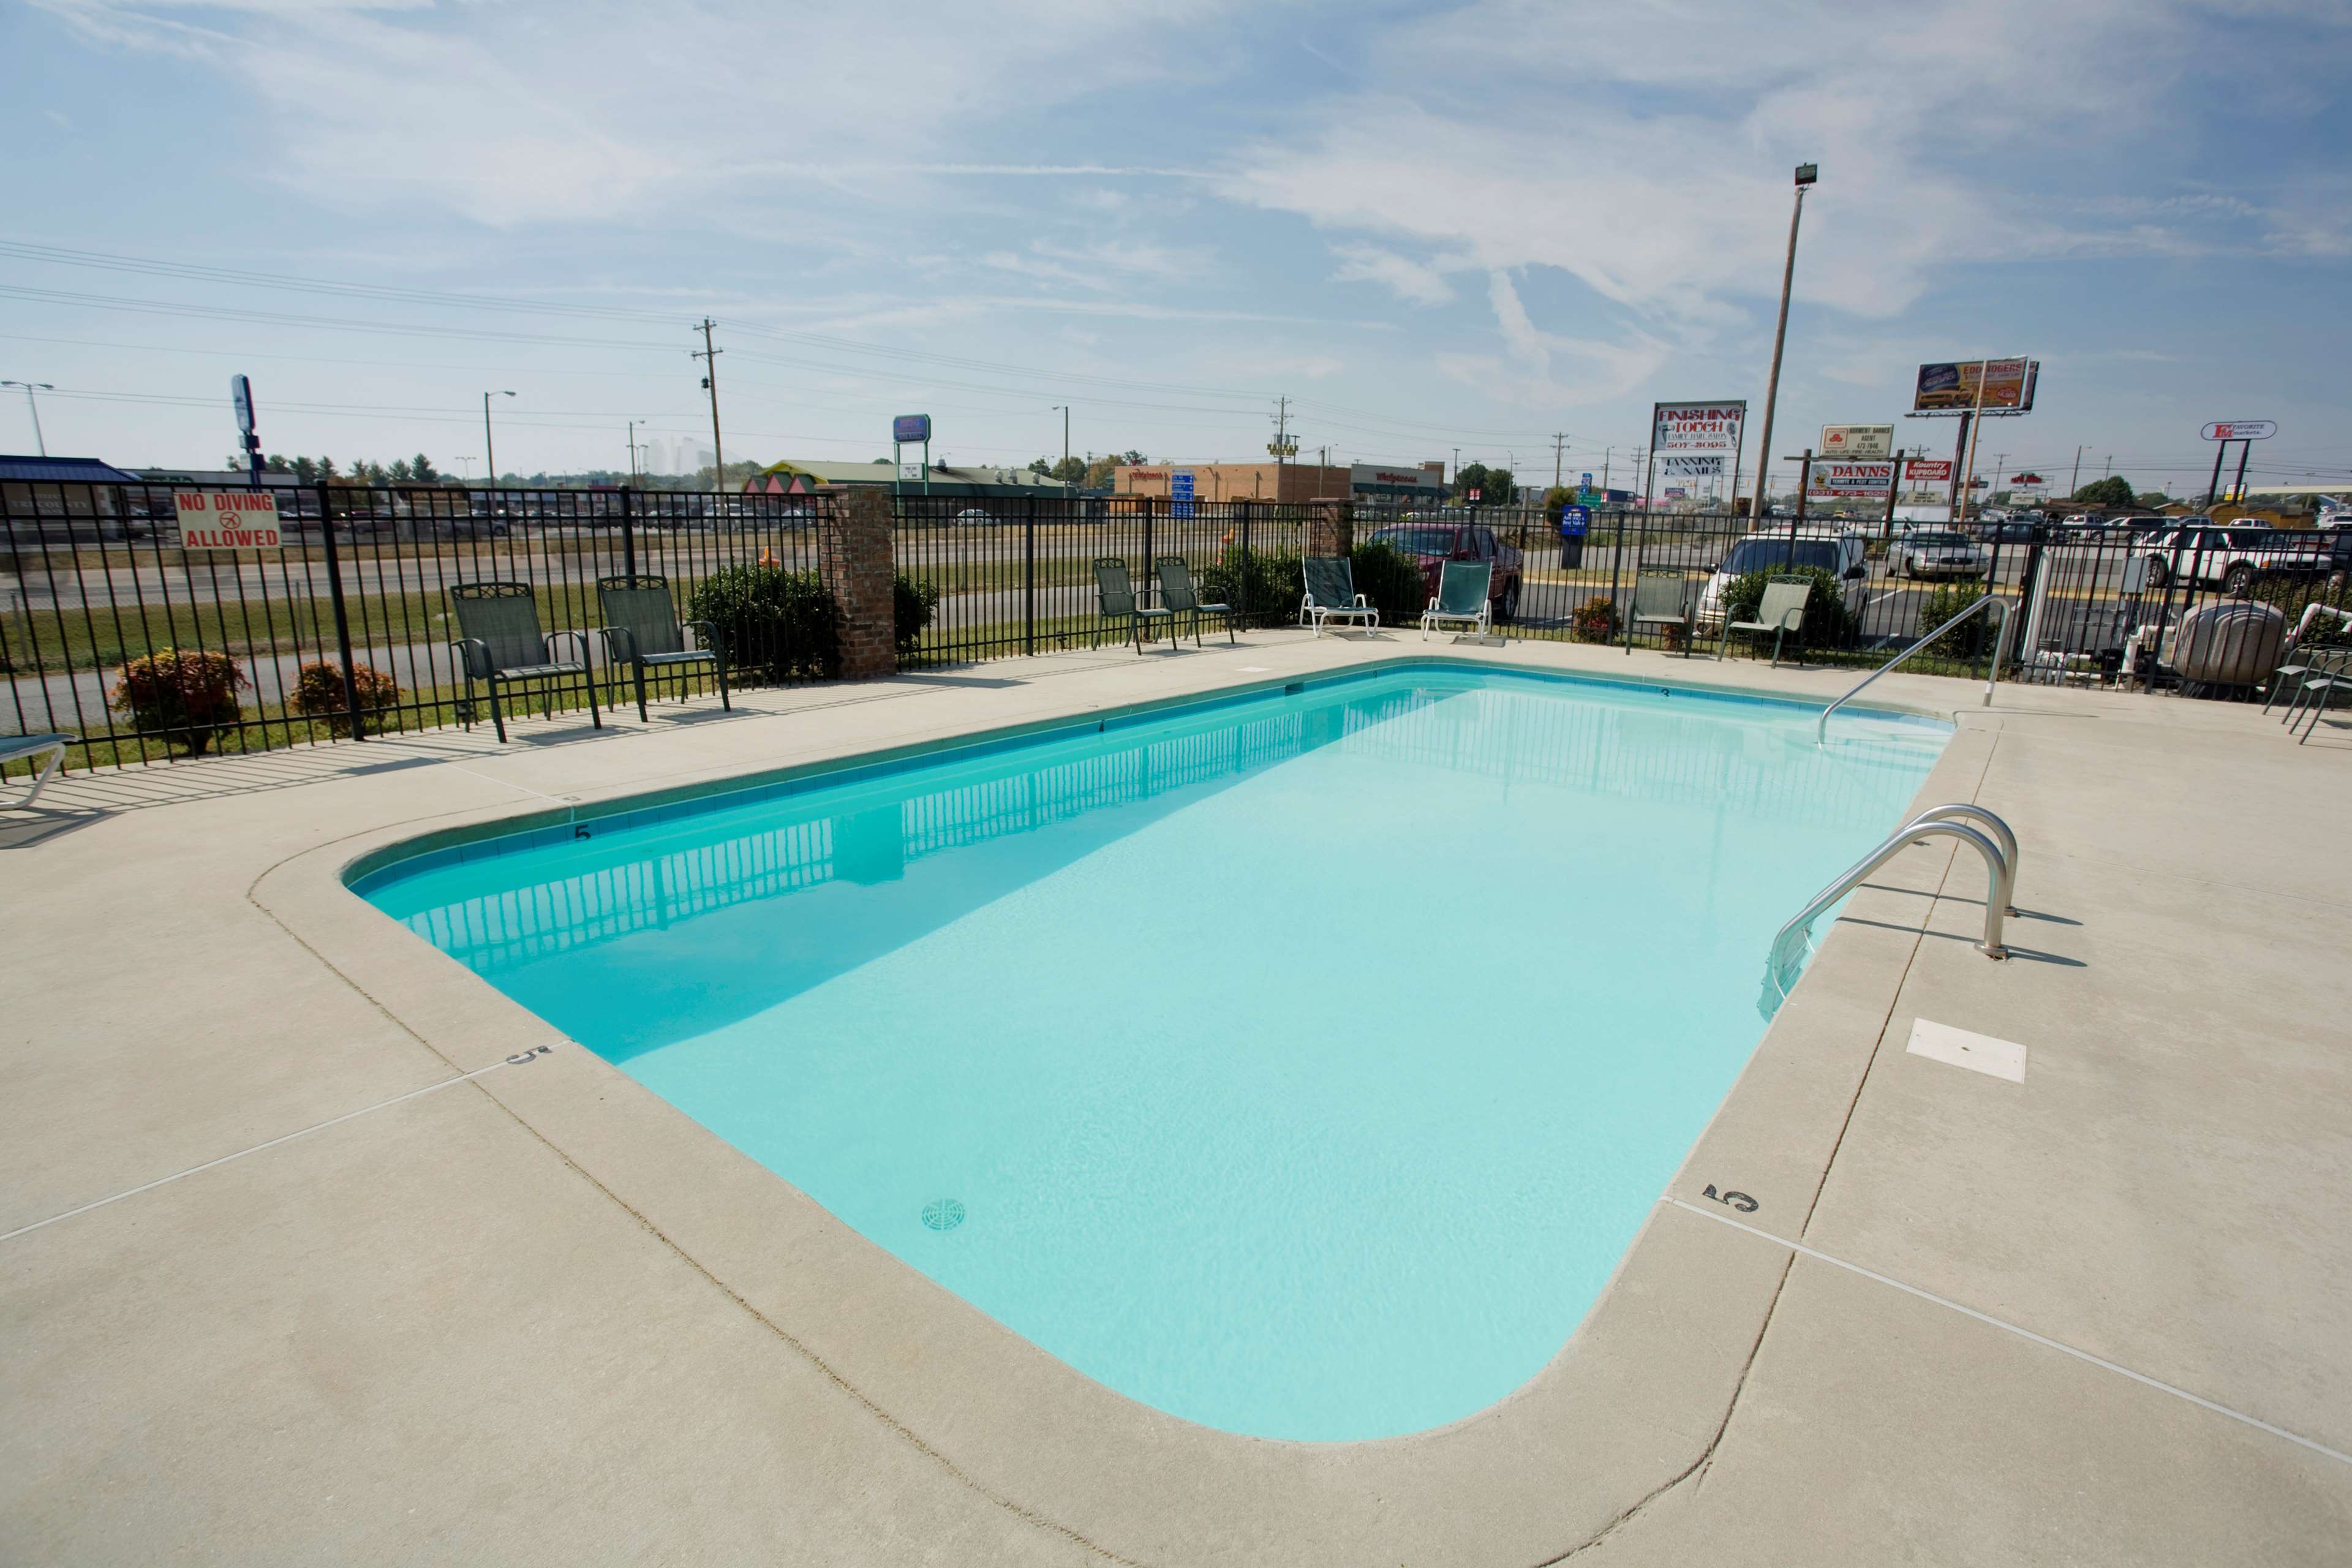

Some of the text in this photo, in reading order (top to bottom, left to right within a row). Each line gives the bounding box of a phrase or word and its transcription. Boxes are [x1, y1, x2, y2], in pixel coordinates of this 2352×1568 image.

[1659, 409, 1741, 421] FINISHING
[1675, 421, 1723, 432] TOUCH
[1665, 457, 1721, 466] TANNING
[1913, 461, 1947, 470] Kountry
[1684, 467, 1721, 475] NAILS
[1832, 466, 1891, 477] DANNS
[1376, 473, 1418, 484] Walgreens
[178, 494, 274, 511] NO DIVING
[187, 530, 278, 547] ALLOWED
[575, 824, 591, 842] 5
[1702, 1184, 1758, 1212] 5
